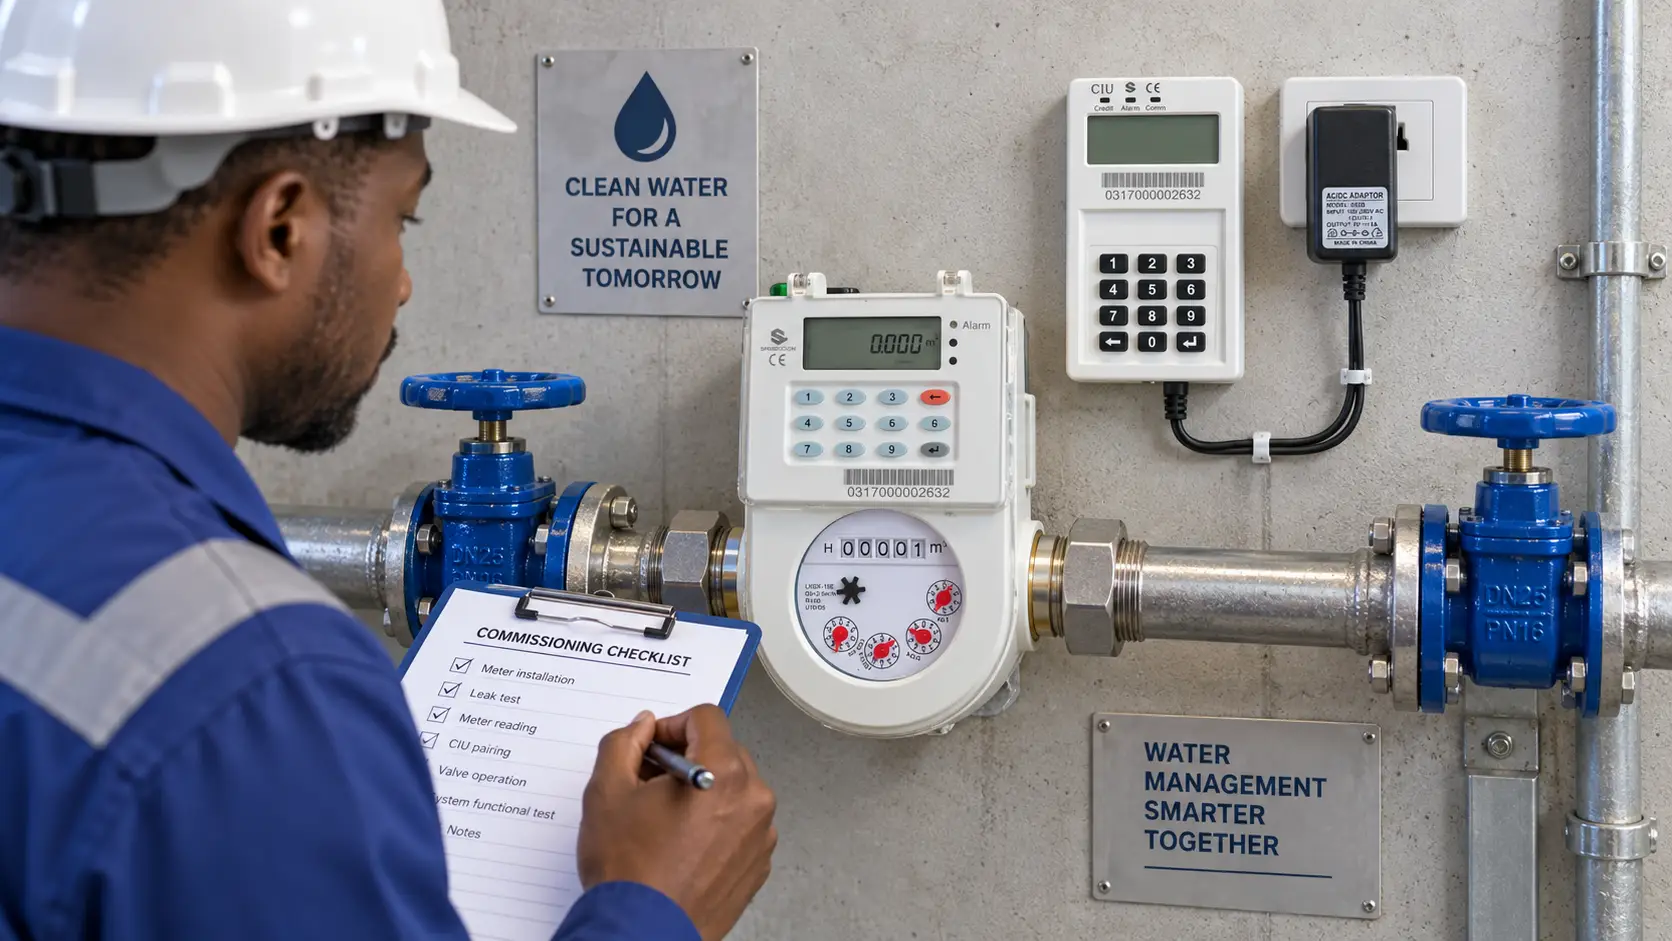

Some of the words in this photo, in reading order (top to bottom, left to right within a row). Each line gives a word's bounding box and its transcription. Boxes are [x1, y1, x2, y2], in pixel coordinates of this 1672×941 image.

[1091, 83, 1114, 94] CIU
[565, 177, 640, 196] CLEAN
[648, 177, 728, 197] WATER
[1105, 190, 1201, 200] 0317000002632
[1349, 191, 1384, 199] ADAPTOR
[612, 207, 658, 227] FOR
[665, 208, 681, 227] A
[570, 238, 729, 259] SUSTAINABLE
[1109, 258, 1116, 269] 1
[1148, 258, 1156, 269] 2
[1187, 258, 1195, 269] 3
[582, 268, 722, 289] TOMORROW
[1109, 284, 1117, 295] 4
[1148, 284, 1156, 295] 5
[1187, 284, 1195, 295] 6
[1109, 310, 1117, 322] 7
[1148, 310, 1156, 322] 8
[1187, 310, 1195, 322] 9
[962, 320, 991, 330] Alarm
[870, 333, 923, 354] 0.000
[1148, 336, 1156, 347] 0
[806, 392, 810, 402] 1
[846, 392, 853, 402] 2
[890, 392, 896, 402] 3
[804, 418, 811, 428] 4
[846, 418, 852, 428] 5
[889, 418, 895, 428] 6
[931, 418, 937, 428] 6
[804, 445, 810, 454] 7
[846, 445, 852, 454] 8
[888, 445, 894, 454] 9
[847, 487, 950, 498] 0317000002632
[824, 543, 833, 553] H
[842, 540, 923, 557] 00001
[1485, 585, 1547, 607] DN25
[1486, 620, 1544, 641] PN16
[476, 626, 604, 655] COMMISSIONING
[606, 645, 692, 668] CHECKLIST
[481, 664, 515, 677] Meter
[516, 668, 576, 685] installation
[469, 688, 498, 701] Leak
[500, 693, 522, 704] test
[459, 713, 493, 726] Meter
[494, 719, 538, 735] reading
[448, 739, 471, 751] CIU
[471, 743, 512, 759] pairing
[1144, 742, 1230, 764] WATER
[439, 765, 469, 779] Valve
[471, 771, 527, 787] operation
[1144, 771, 1327, 798] MANAGEMENT
[434, 790, 470, 806] ystem
[472, 798, 531, 816] functional
[532, 808, 556, 820] test
[1144, 800, 1266, 825] SMARTER
[447, 825, 482, 839] Notes
[1144, 829, 1279, 856] TOGETHER
